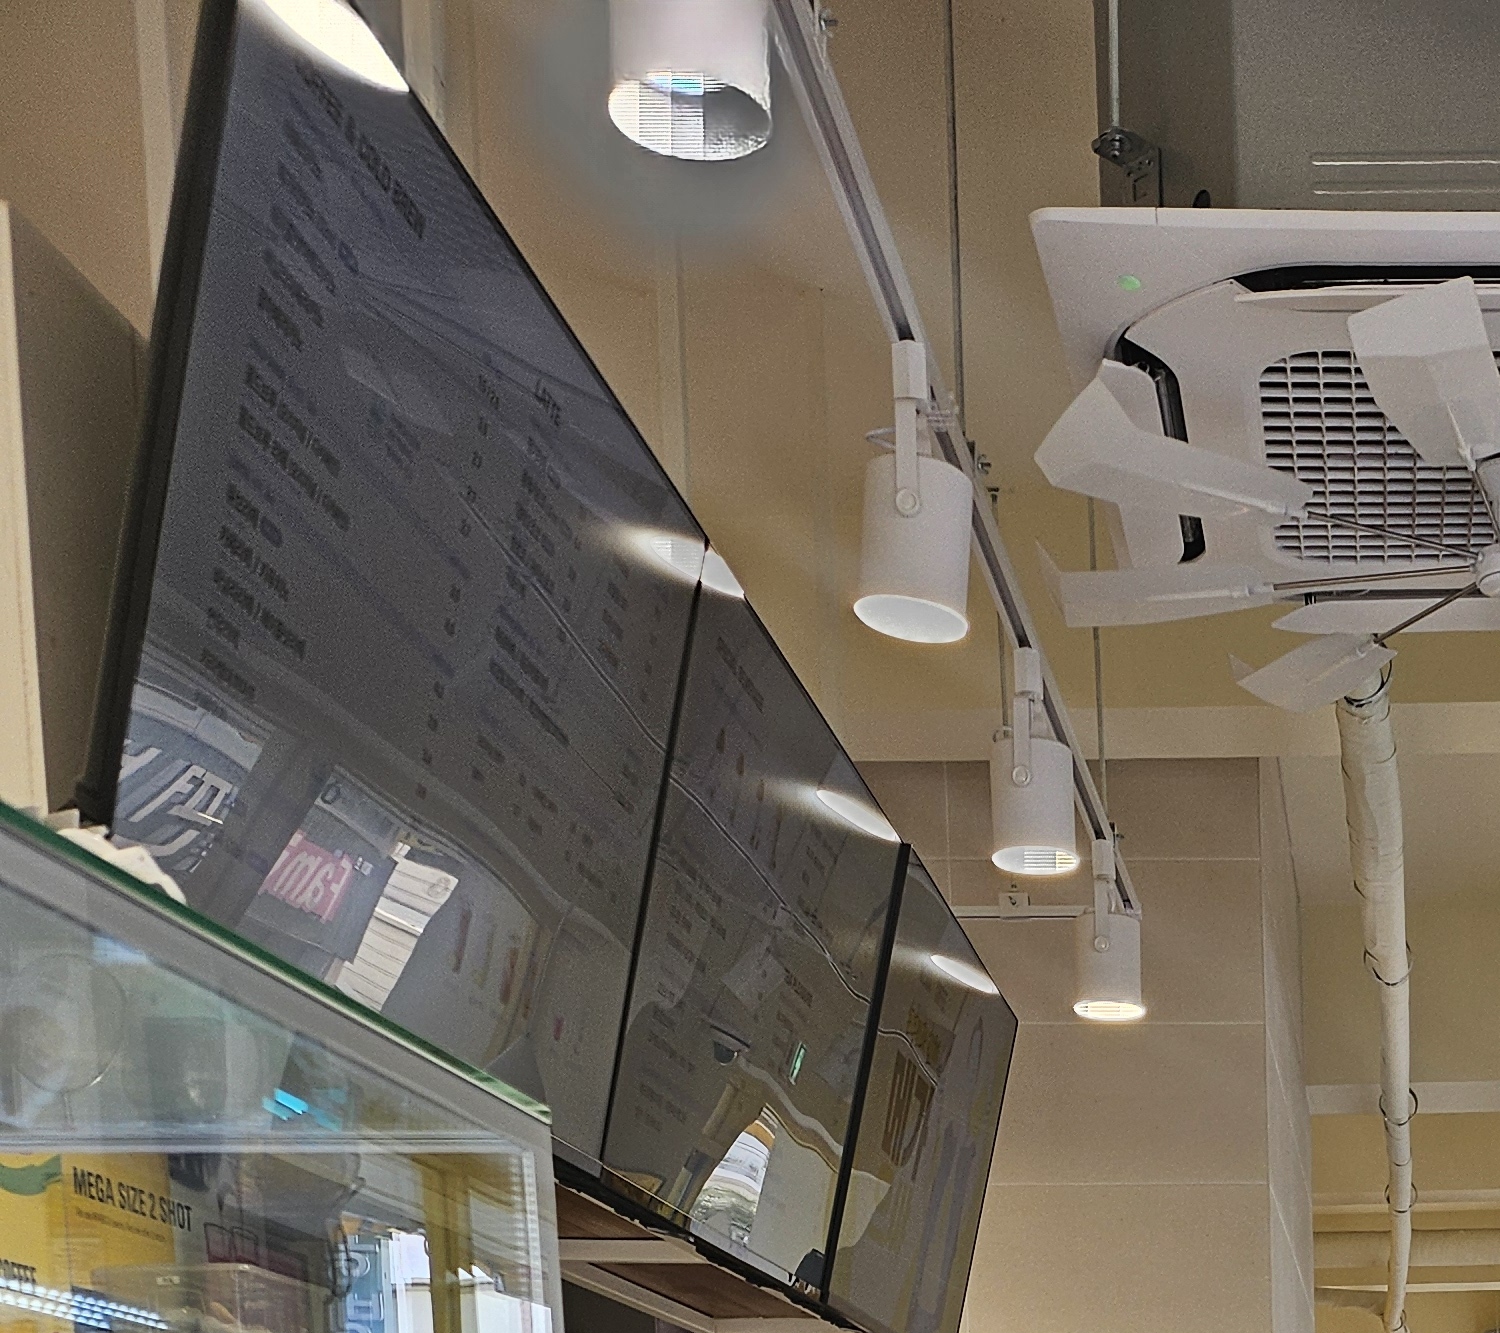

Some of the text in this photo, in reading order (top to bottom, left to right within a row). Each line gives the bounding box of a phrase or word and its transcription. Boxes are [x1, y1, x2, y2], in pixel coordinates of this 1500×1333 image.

[73, 1166, 116, 1207] MEGA
[117, 1181, 147, 1217] SIZE
[149, 1192, 158, 1220] 2
[159, 1195, 193, 1232] SHOT
